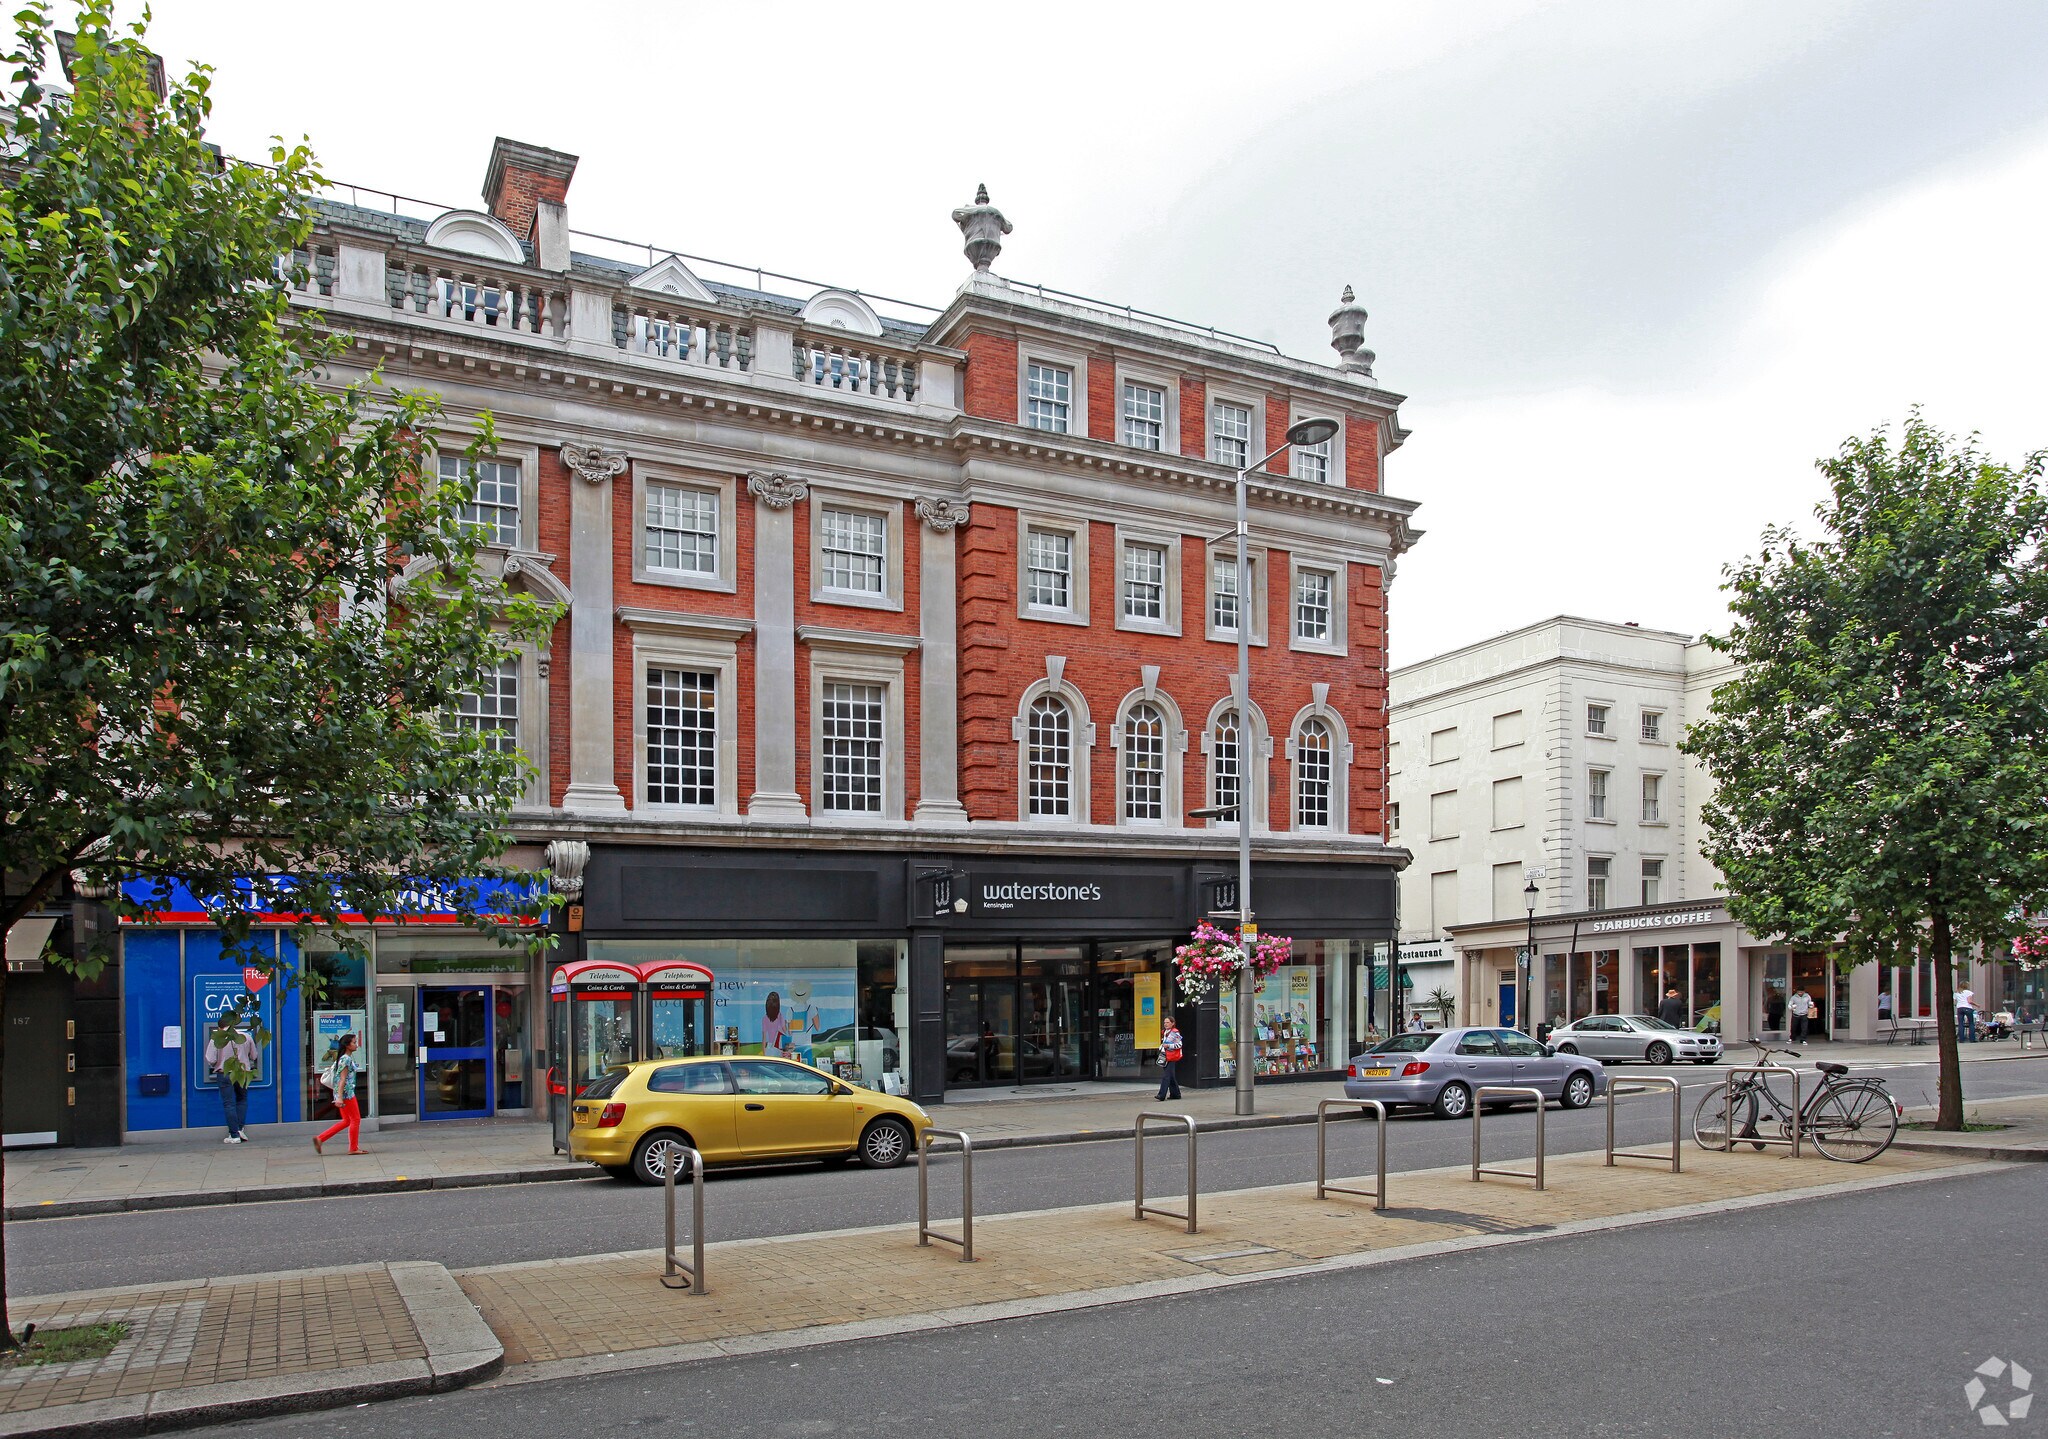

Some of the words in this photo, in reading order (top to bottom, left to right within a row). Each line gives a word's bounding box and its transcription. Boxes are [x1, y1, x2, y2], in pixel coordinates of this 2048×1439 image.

[983, 882, 1101, 900] waterstone's
[1593, 917, 1661, 932] STARBUCKS
[1664, 912, 1712, 925] COFFEE
[589, 972, 621, 980] Telephone
[664, 972, 695, 980] Telephone
[13, 1017, 30, 1025] 187
